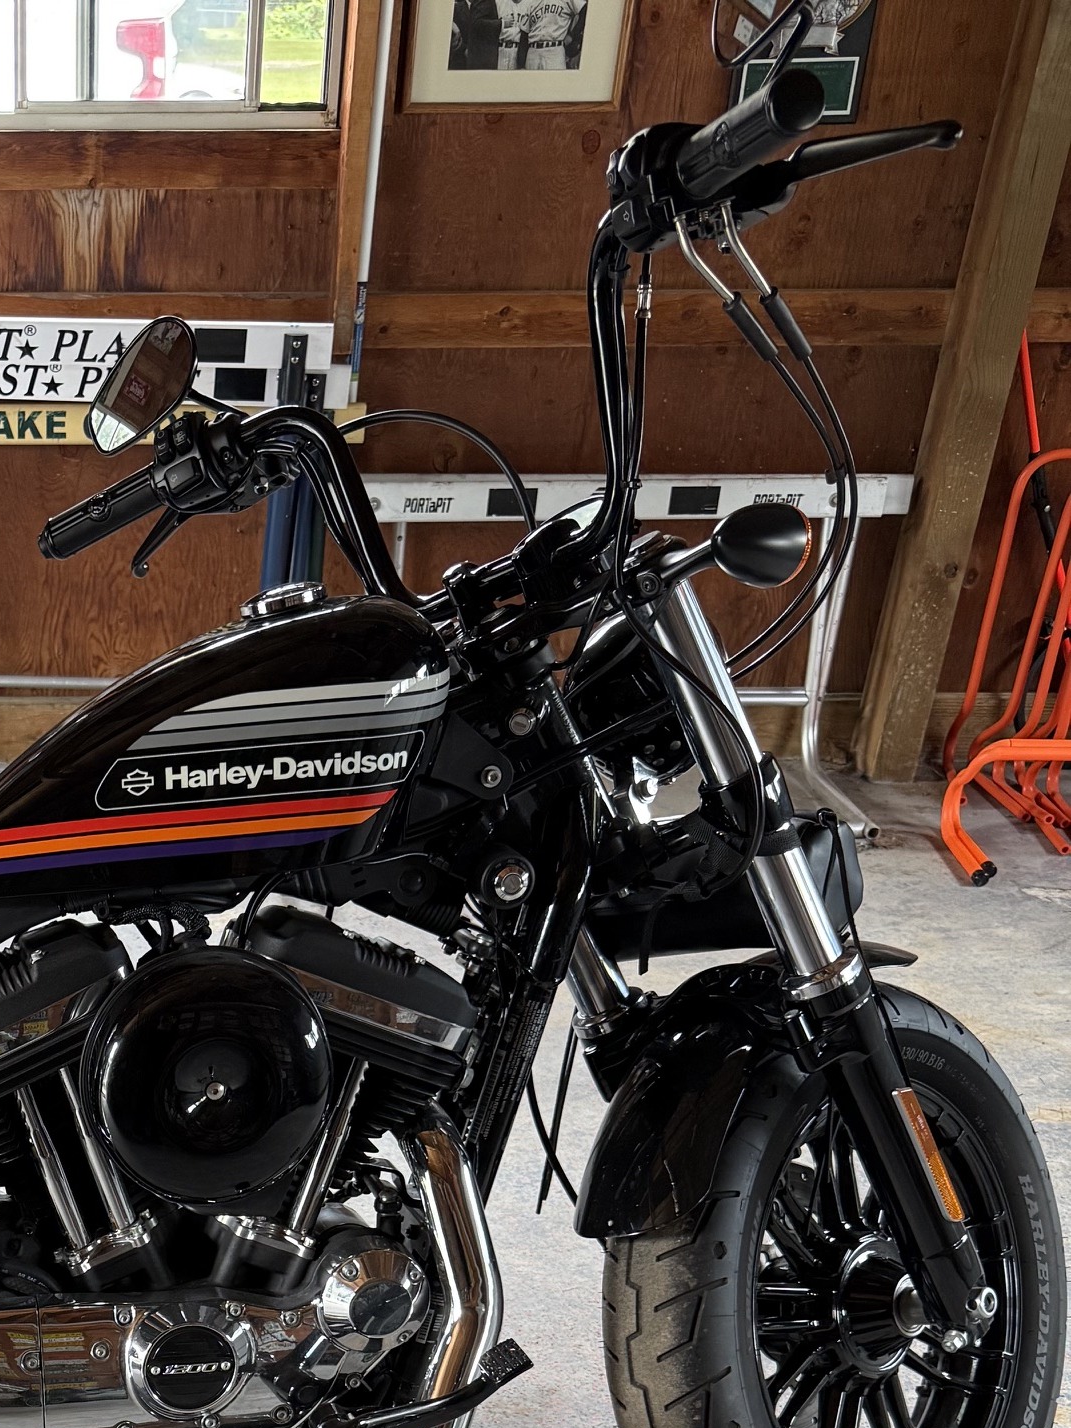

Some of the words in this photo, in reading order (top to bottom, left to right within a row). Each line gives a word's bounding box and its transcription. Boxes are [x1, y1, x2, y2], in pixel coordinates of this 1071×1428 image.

[530, 4, 564, 24] DETROIT
[50, 329, 127, 362] PLA
[164, 750, 408, 790] Harley-Davidson
[162, 1362, 219, 1375] 1200
